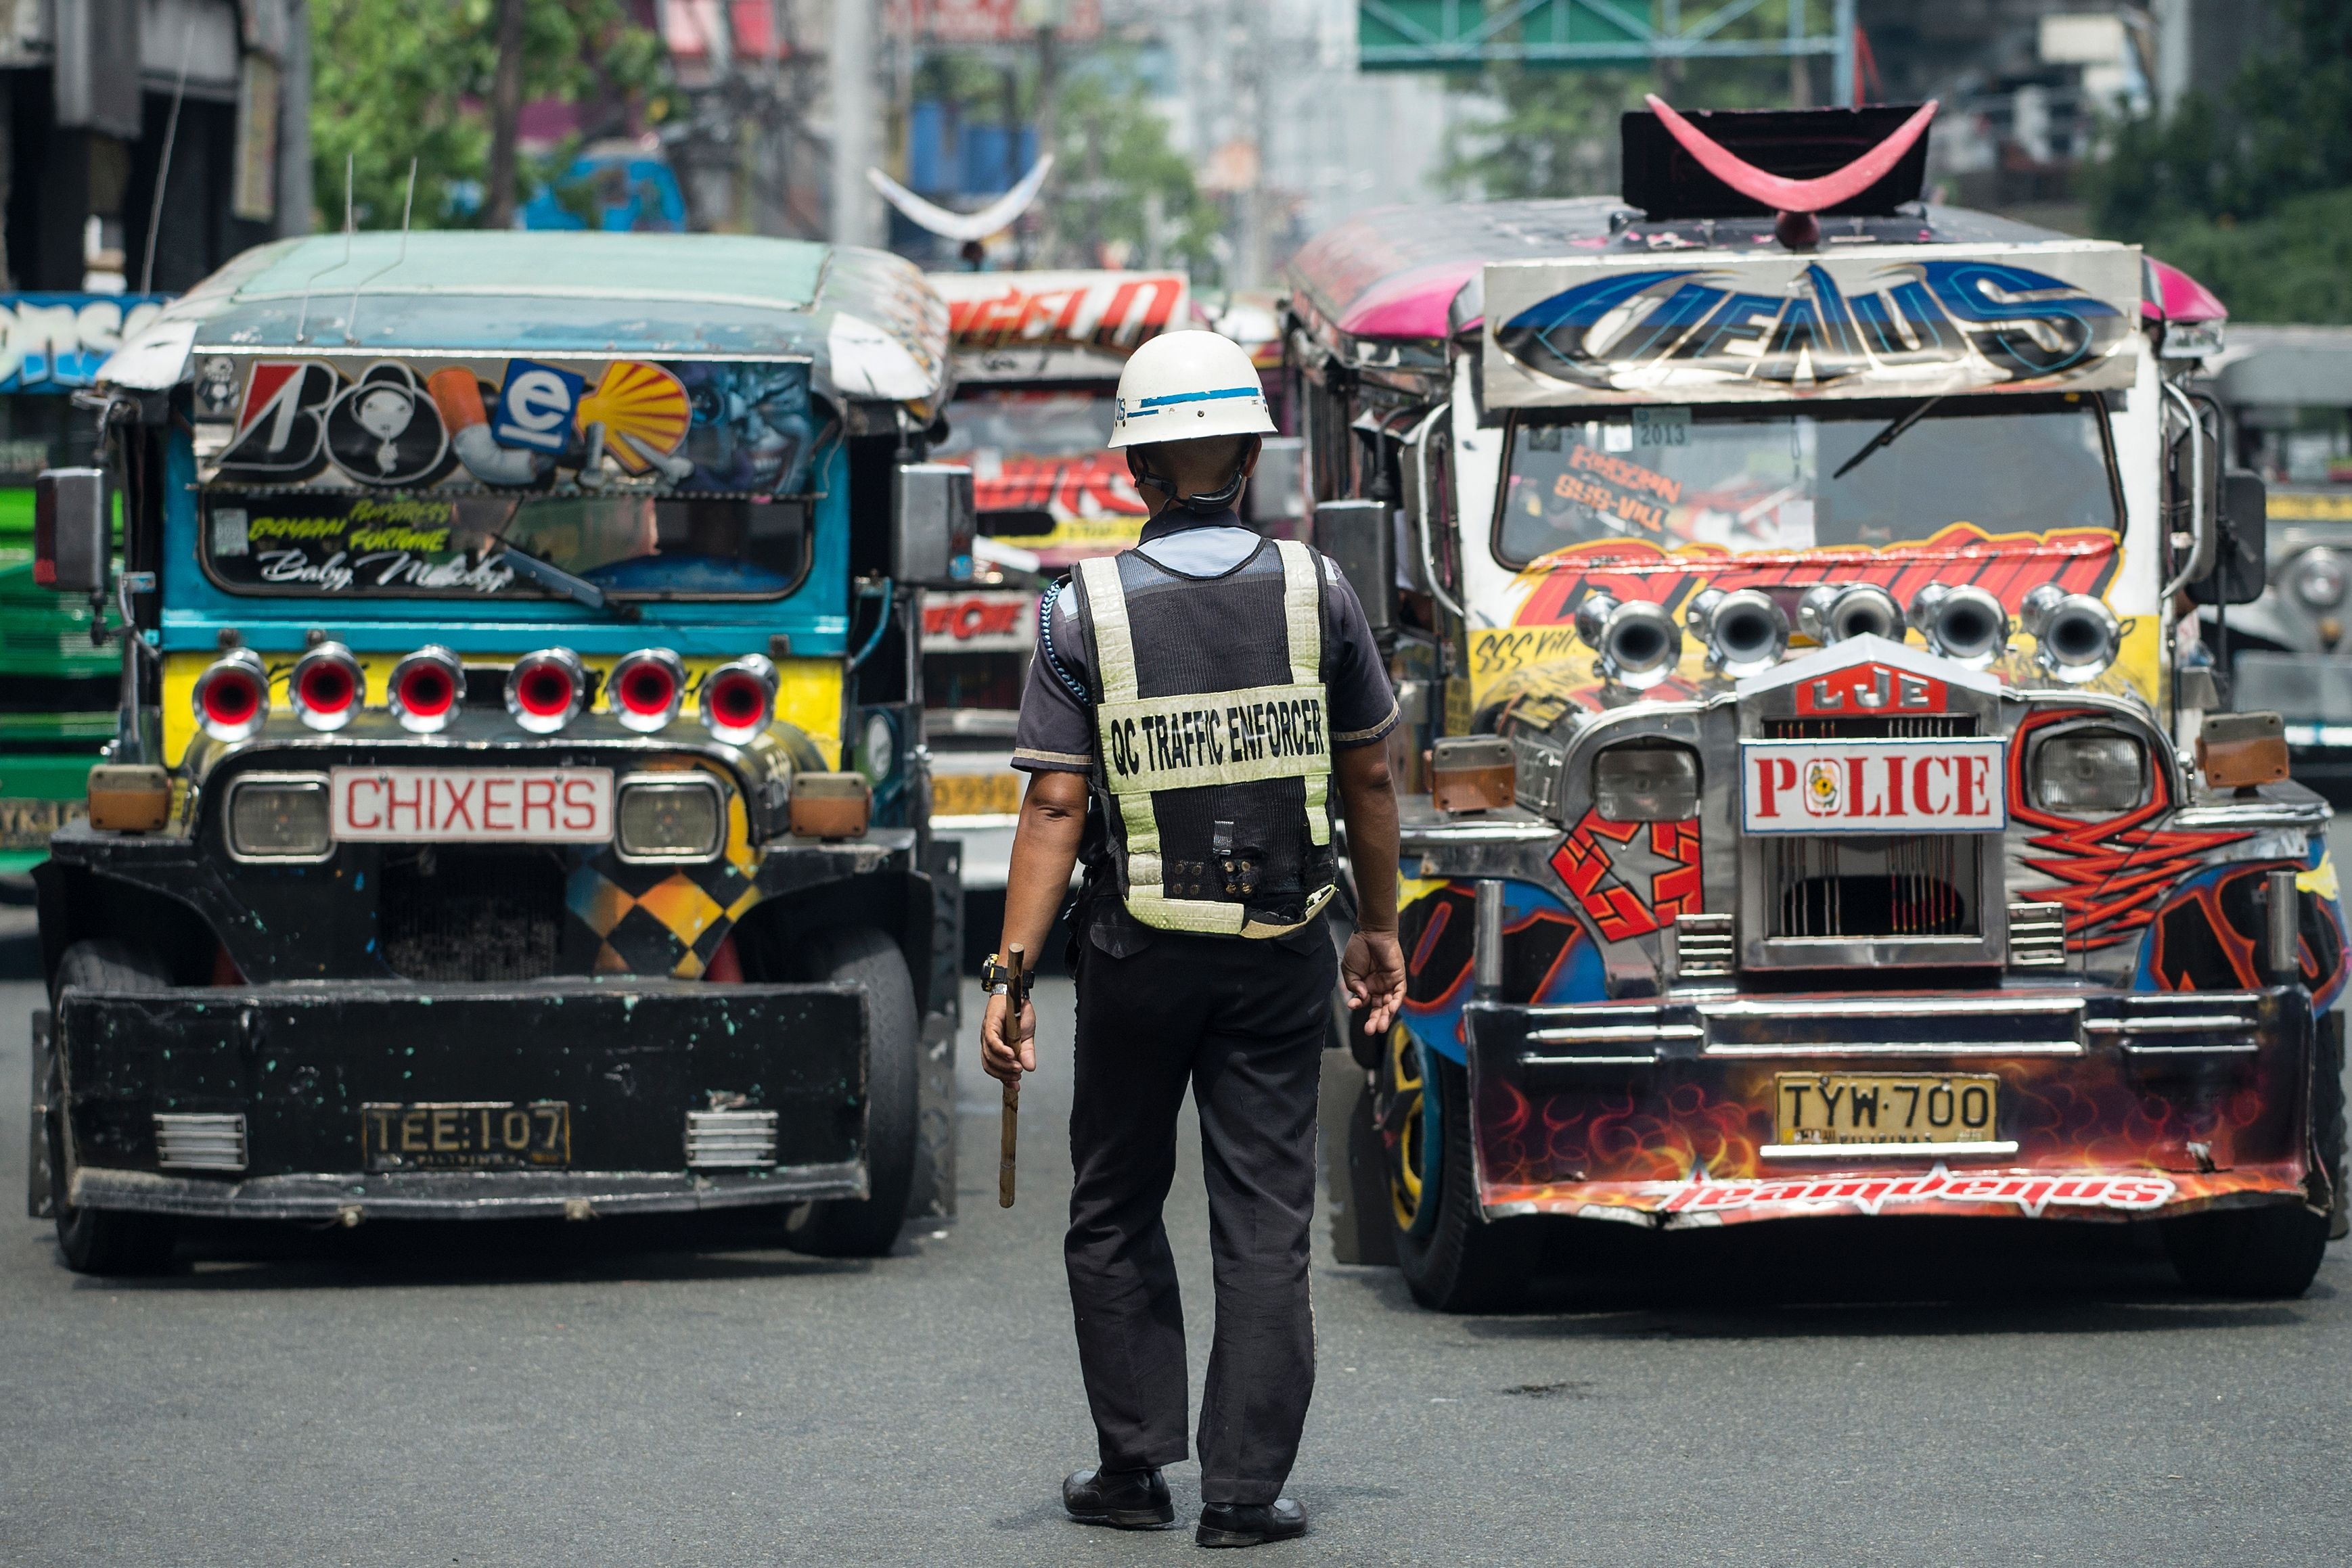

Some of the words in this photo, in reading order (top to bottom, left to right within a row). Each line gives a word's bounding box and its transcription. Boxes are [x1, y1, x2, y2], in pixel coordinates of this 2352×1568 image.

[1640, 424, 1686, 445] 2013
[1476, 632, 1533, 674] SSS
[1812, 667, 1930, 710] LJE
[1110, 718, 1141, 781] QC
[1141, 708, 1224, 772] TRAFFIC
[1226, 699, 1326, 763] ENFORCER
[347, 779, 597, 830] CHIXERS
[1754, 754, 1991, 818] POLICE
